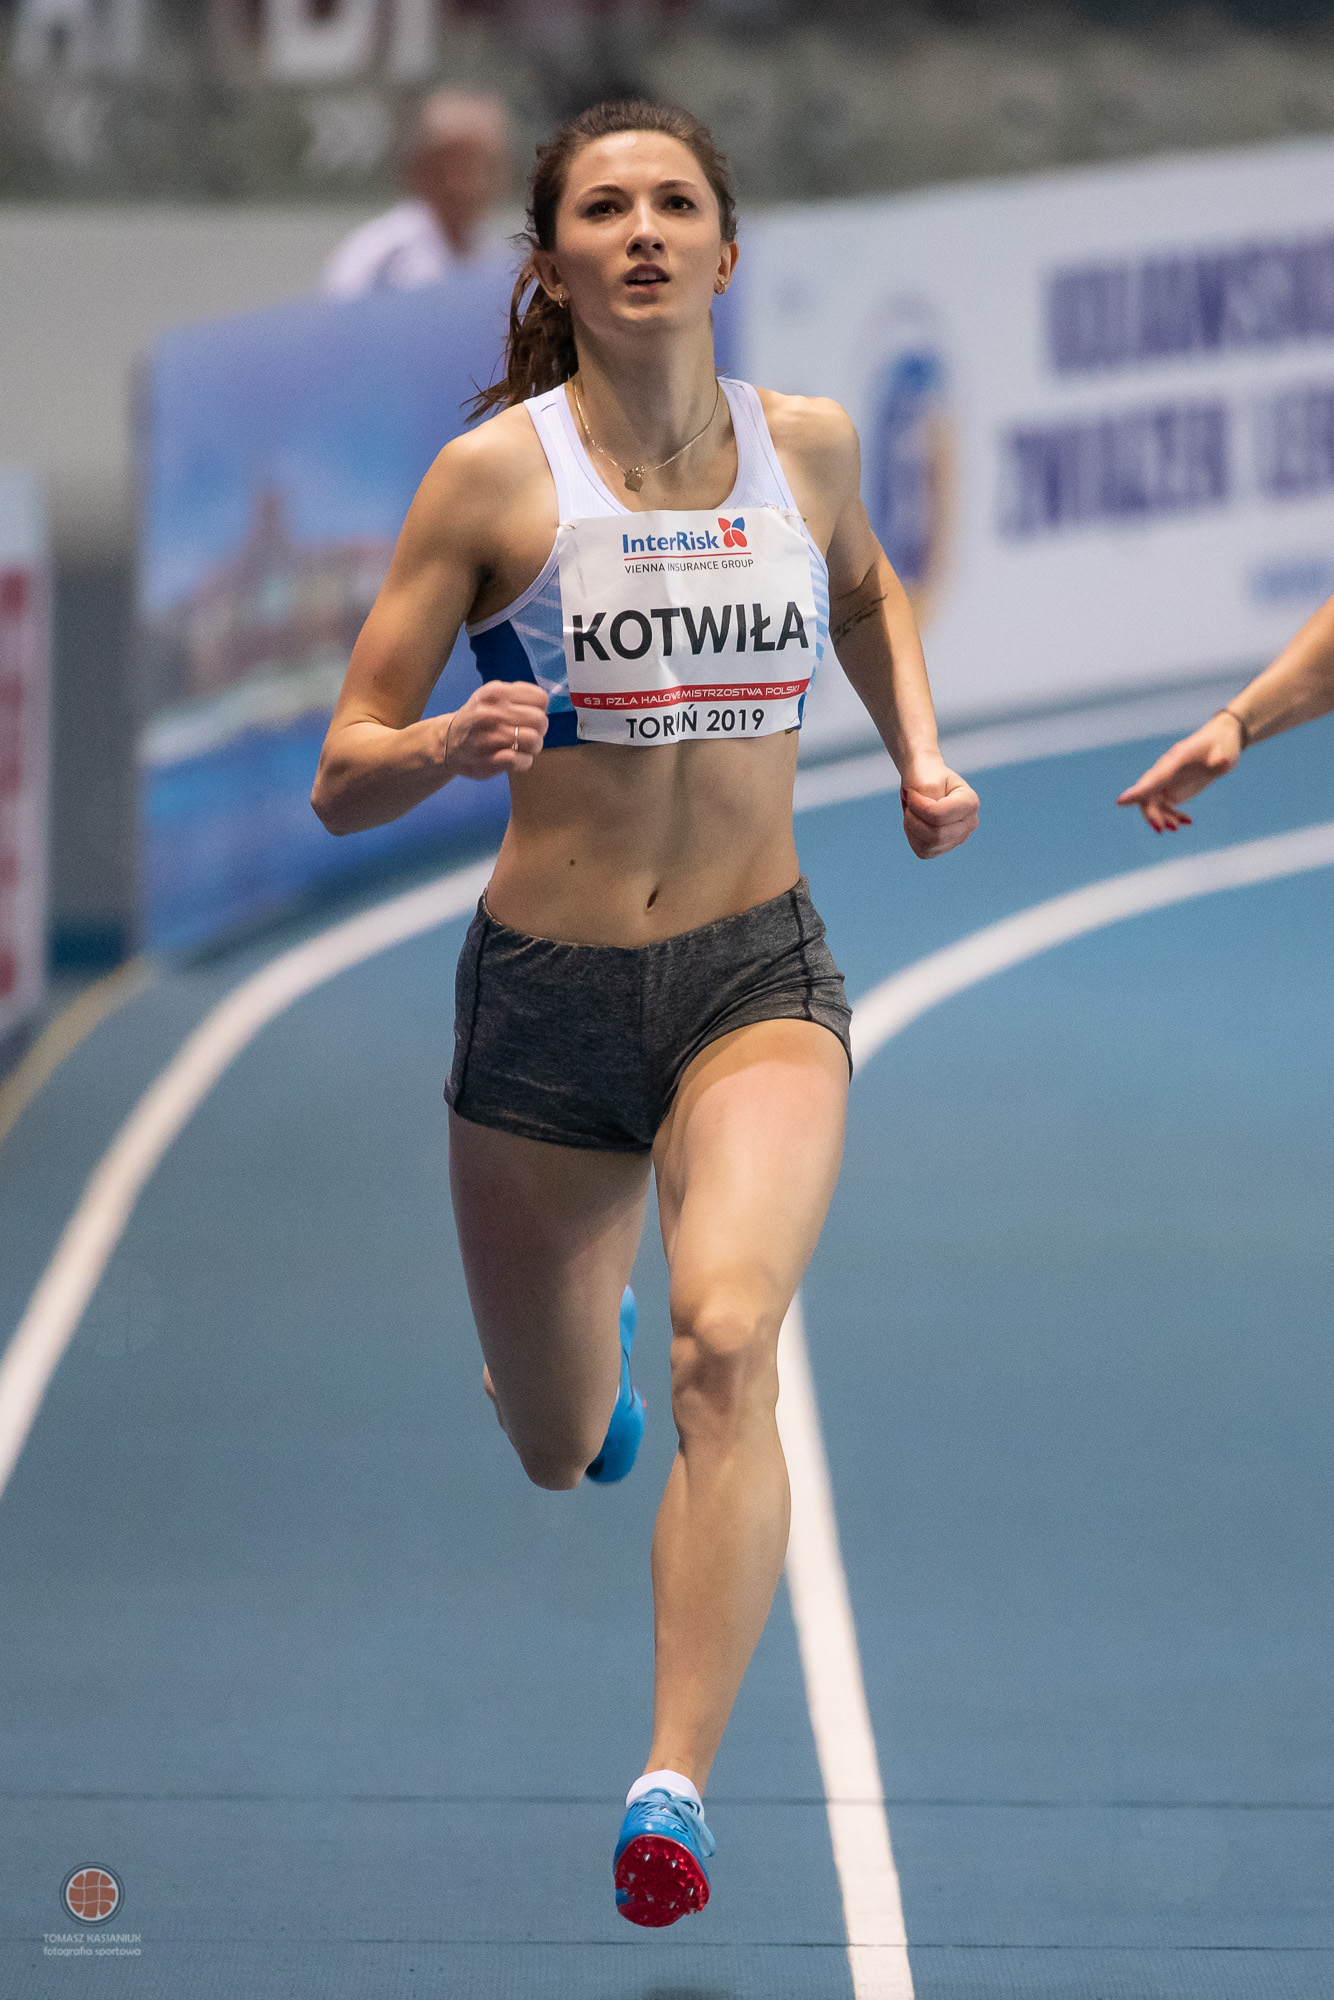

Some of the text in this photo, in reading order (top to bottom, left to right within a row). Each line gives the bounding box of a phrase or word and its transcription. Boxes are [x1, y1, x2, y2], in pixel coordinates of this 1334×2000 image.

[622, 530, 720, 554] InterRisk
[624, 558, 754, 574] VIENNA INSURANCE GROUP
[572, 601, 809, 662] KOTWIŁA
[583, 684, 800, 706] 63. PZLA HALOWE MISTRZOSTWA POLSKI
[706, 708, 765, 732] 2019
